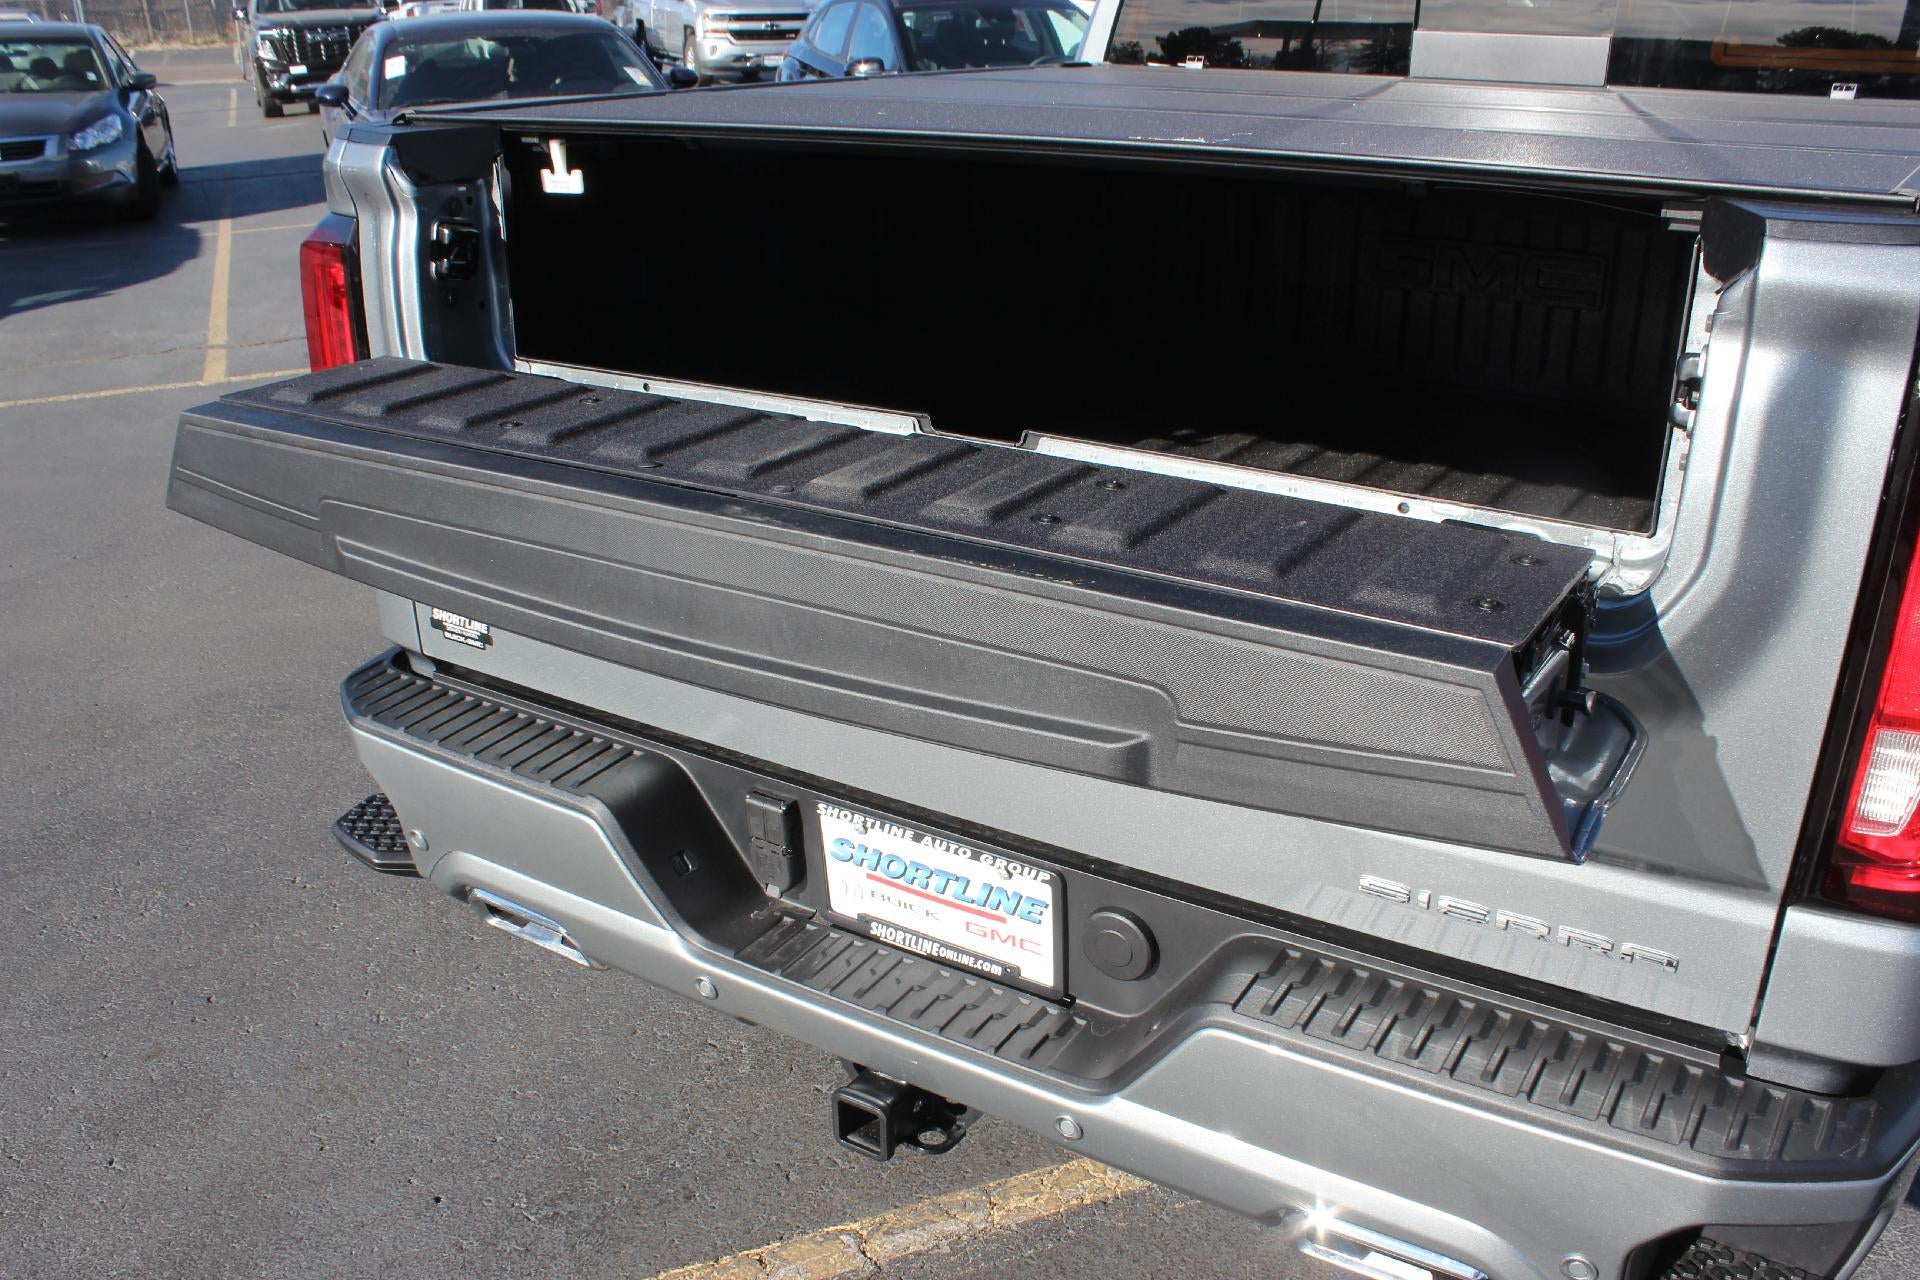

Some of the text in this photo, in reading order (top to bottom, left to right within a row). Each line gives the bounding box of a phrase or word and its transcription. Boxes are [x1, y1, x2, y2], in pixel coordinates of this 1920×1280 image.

[1360, 235, 1609, 312] GMC
[433, 607, 488, 634] SHORTLINE
[816, 803, 1051, 884] SHORTLINE AUTO GROUP
[829, 837, 1049, 925] SHORTLINE
[870, 890, 938, 921] BUICK
[965, 920, 1041, 956] GMC
[1358, 875, 1680, 974] SIERRA
